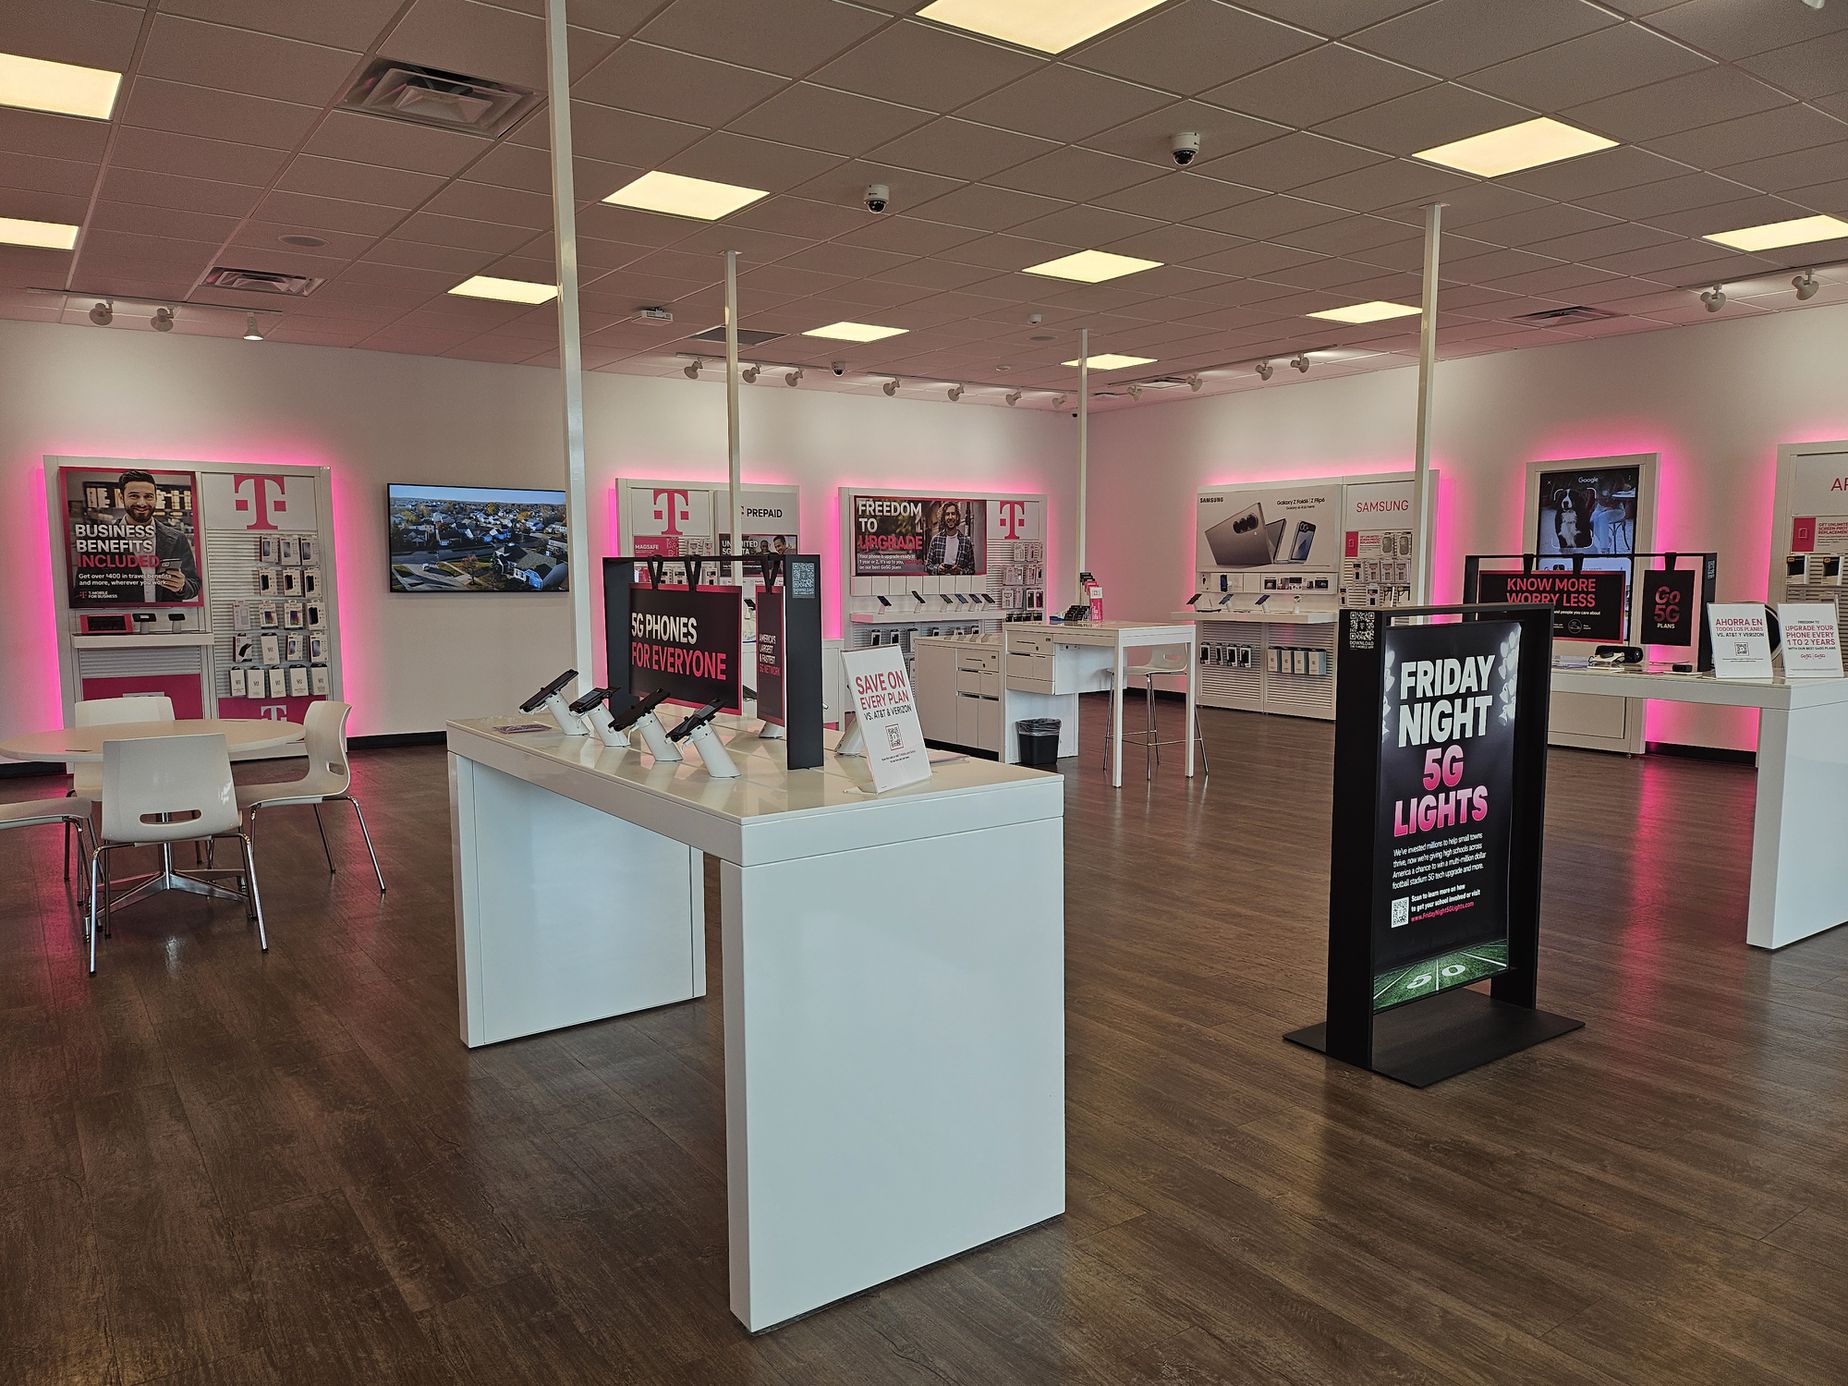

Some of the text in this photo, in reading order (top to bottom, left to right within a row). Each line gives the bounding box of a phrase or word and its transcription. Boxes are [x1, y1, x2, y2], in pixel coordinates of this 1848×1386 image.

[747, 508, 782, 518] PREPAID
[858, 501, 922, 517] FREEDOM
[1356, 500, 1409, 513] SAMSUNG
[76, 524, 155, 538] BUSINESS
[859, 518, 878, 532] TO
[76, 540, 153, 552] BENEFITS
[858, 535, 923, 550] UPGRADE
[77, 554, 160, 568] INCLUDED
[1507, 578, 1596, 591] KNOW MORE
[1507, 593, 1595, 607] WORRY LESS
[1655, 586, 1680, 604] Go
[1654, 605, 1680, 623] 5G
[631, 612, 698, 644] 5G PHONES
[632, 642, 726, 680] FOR EVERYONE
[856, 670, 905, 695] SAVE ON
[1400, 655, 1495, 700] FRIDAY
[860, 690, 909, 710] EVERY PLAN
[864, 712, 873, 721] VS.
[874, 708, 886, 719] AT&T
[891, 704, 912, 715] VERIZON
[1398, 696, 1493, 748] NIGHT
[1423, 744, 1464, 791] 5G
[1394, 785, 1488, 837] LIGHTS
[1393, 848, 1407, 857] We've
[1408, 843, 1426, 854] invested
[1427, 841, 1442, 849] millions
[1448, 837, 1458, 845] help
[1458, 834, 1469, 843] small
[1430, 851, 1442, 861] giving
[1443, 849, 1452, 858] high
[1453, 846, 1468, 855] schools
[1469, 843, 1482, 851] across
[1392, 869, 1411, 879] America
[1415, 865, 1431, 874] chance
[1449, 855, 1474, 865] multi-million
[1475, 852, 1486, 860] dollar
[1392, 879, 1409, 889] football
[1410, 876, 1427, 886] stadium
[1428, 873, 1434, 881] 5G
[1445, 868, 1462, 878] upgrade
[1463, 865, 1471, 873] and
[1425, 902, 1434, 910] your
[1435, 897, 1448, 906] school
[1449, 893, 1466, 902] involved
